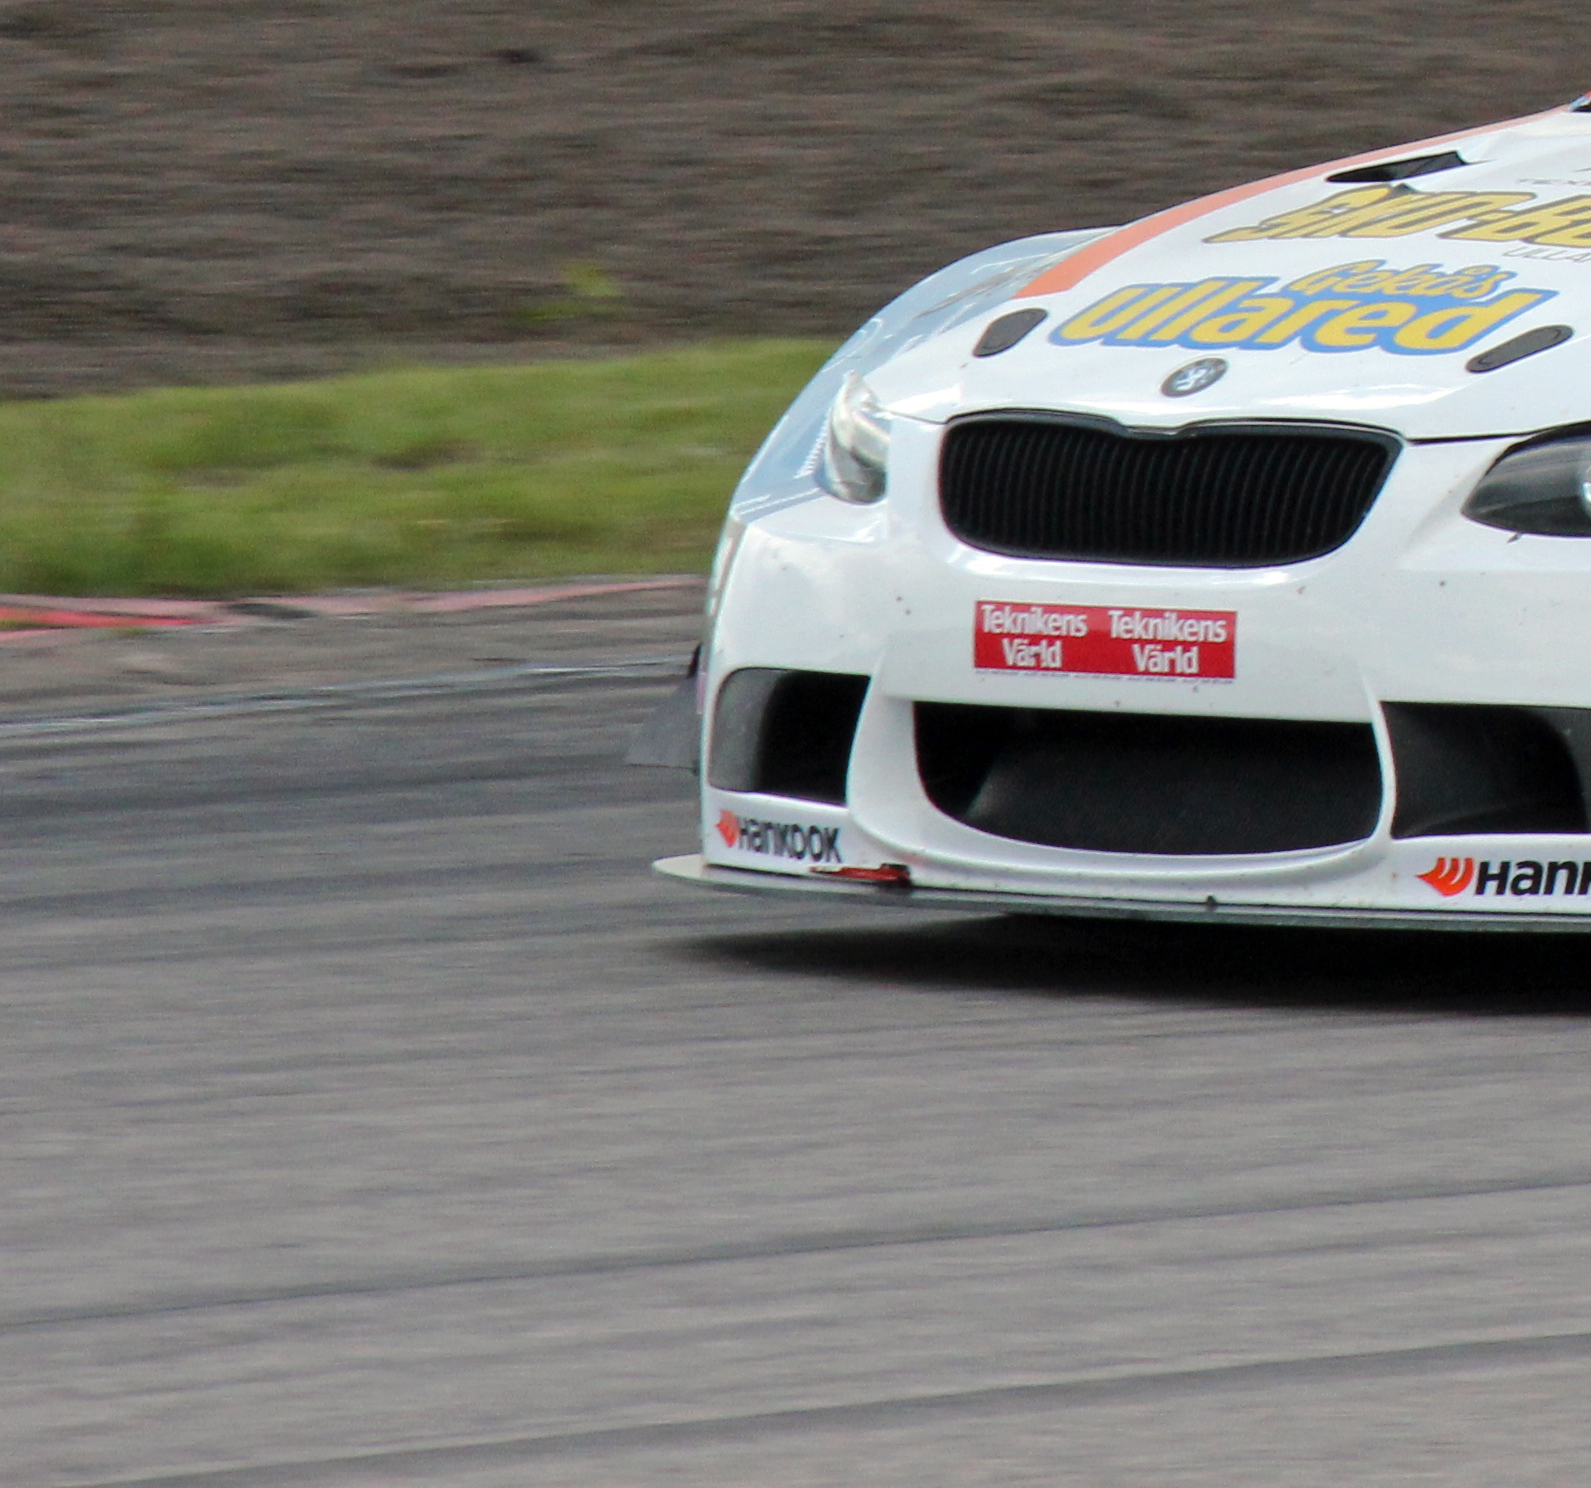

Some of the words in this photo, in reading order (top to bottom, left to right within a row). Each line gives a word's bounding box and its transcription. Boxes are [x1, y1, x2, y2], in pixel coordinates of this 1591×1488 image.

[981, 604, 1089, 637] Teknikens
[1108, 610, 1227, 643] Teknikens
[1002, 638, 1062, 668] Värld
[1132, 643, 1199, 674] Värld
